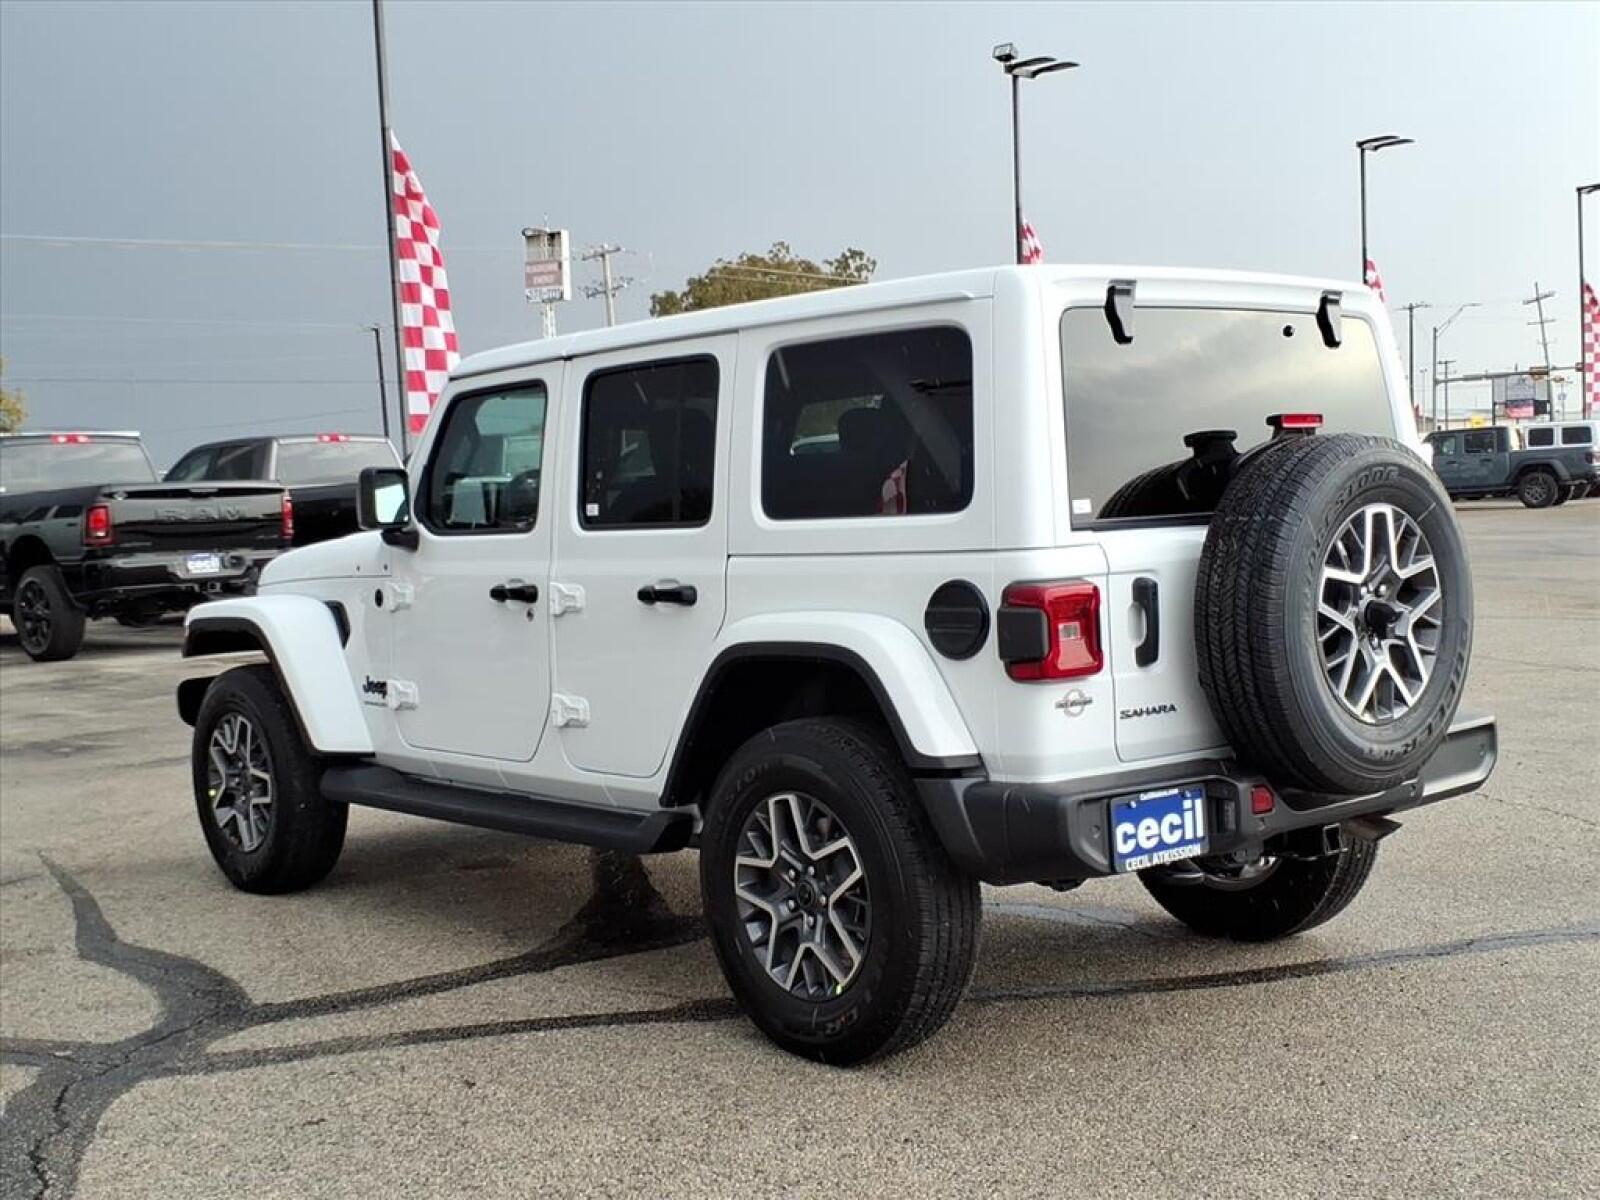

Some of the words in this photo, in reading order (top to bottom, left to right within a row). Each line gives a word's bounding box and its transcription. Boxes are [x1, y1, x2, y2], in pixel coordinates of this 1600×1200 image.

[362, 674, 388, 700] Jeep
[1119, 703, 1177, 720] SAHARA
[1115, 798, 1204, 854] cecil
